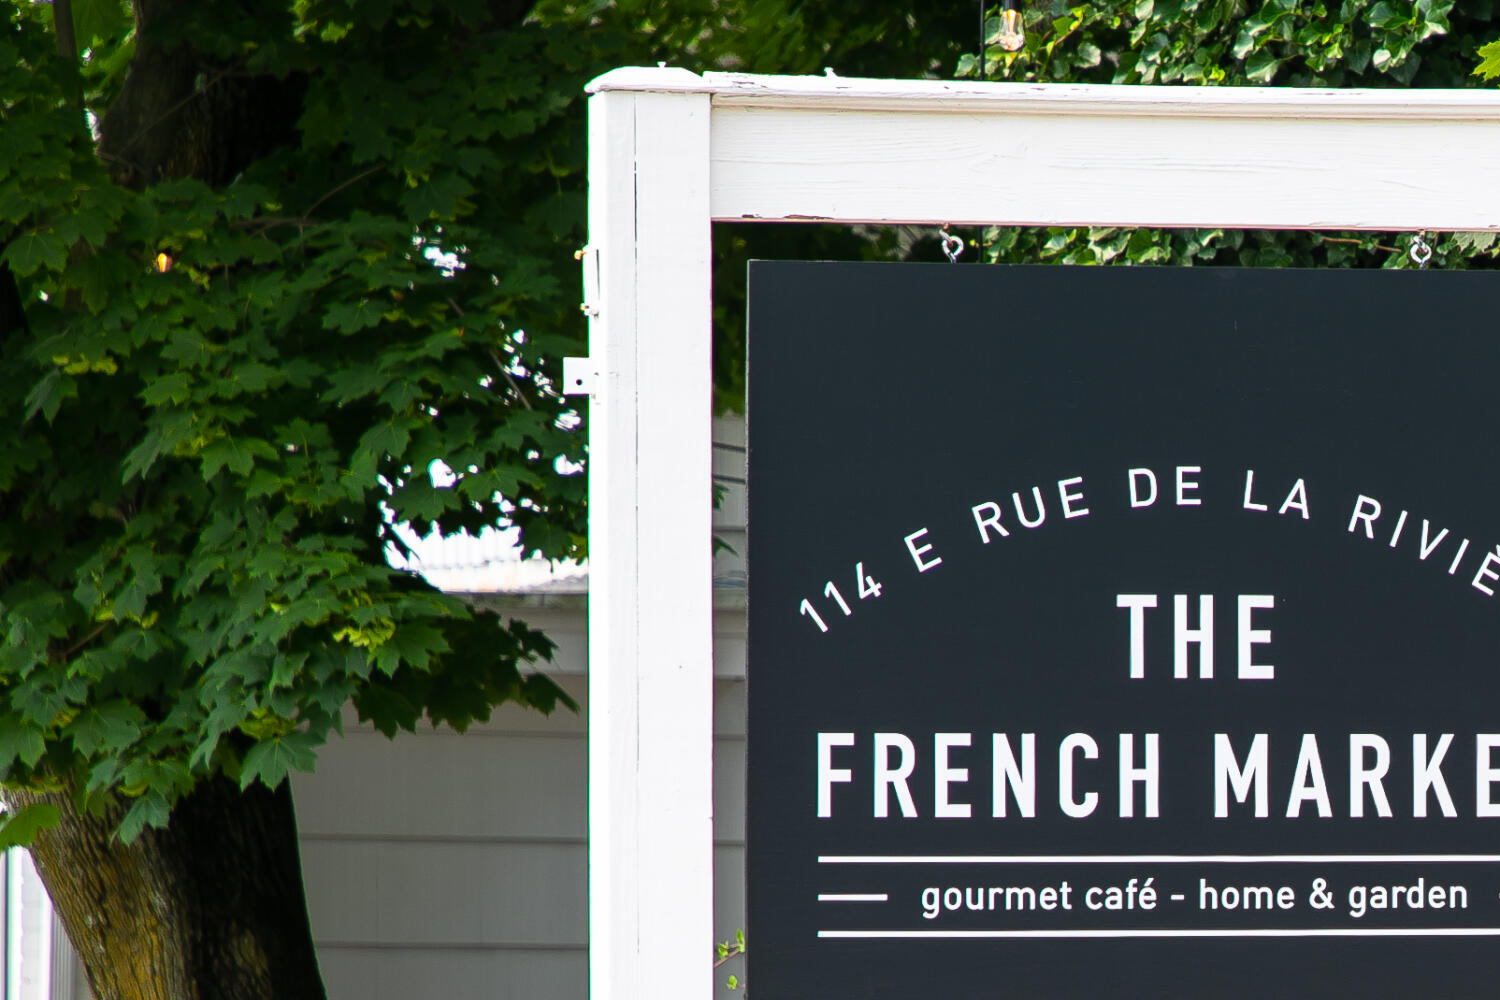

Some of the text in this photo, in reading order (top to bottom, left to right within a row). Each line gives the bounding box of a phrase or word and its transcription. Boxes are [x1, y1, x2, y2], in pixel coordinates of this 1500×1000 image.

[799, 561, 882, 633] 114
[903, 527, 943, 573] E
[971, 476, 1090, 544] RUE
[1128, 465, 1203, 508] DE
[1243, 469, 1310, 520] LA
[1116, 593, 1276, 680] THE
[817, 732, 1160, 819] FRENCH
[921, 881, 1073, 920] gourmet
[1085, 877, 1158, 911] café
[1199, 878, 1295, 911] home
[1308, 877, 1335, 910] &
[1348, 877, 1468, 918] garden
